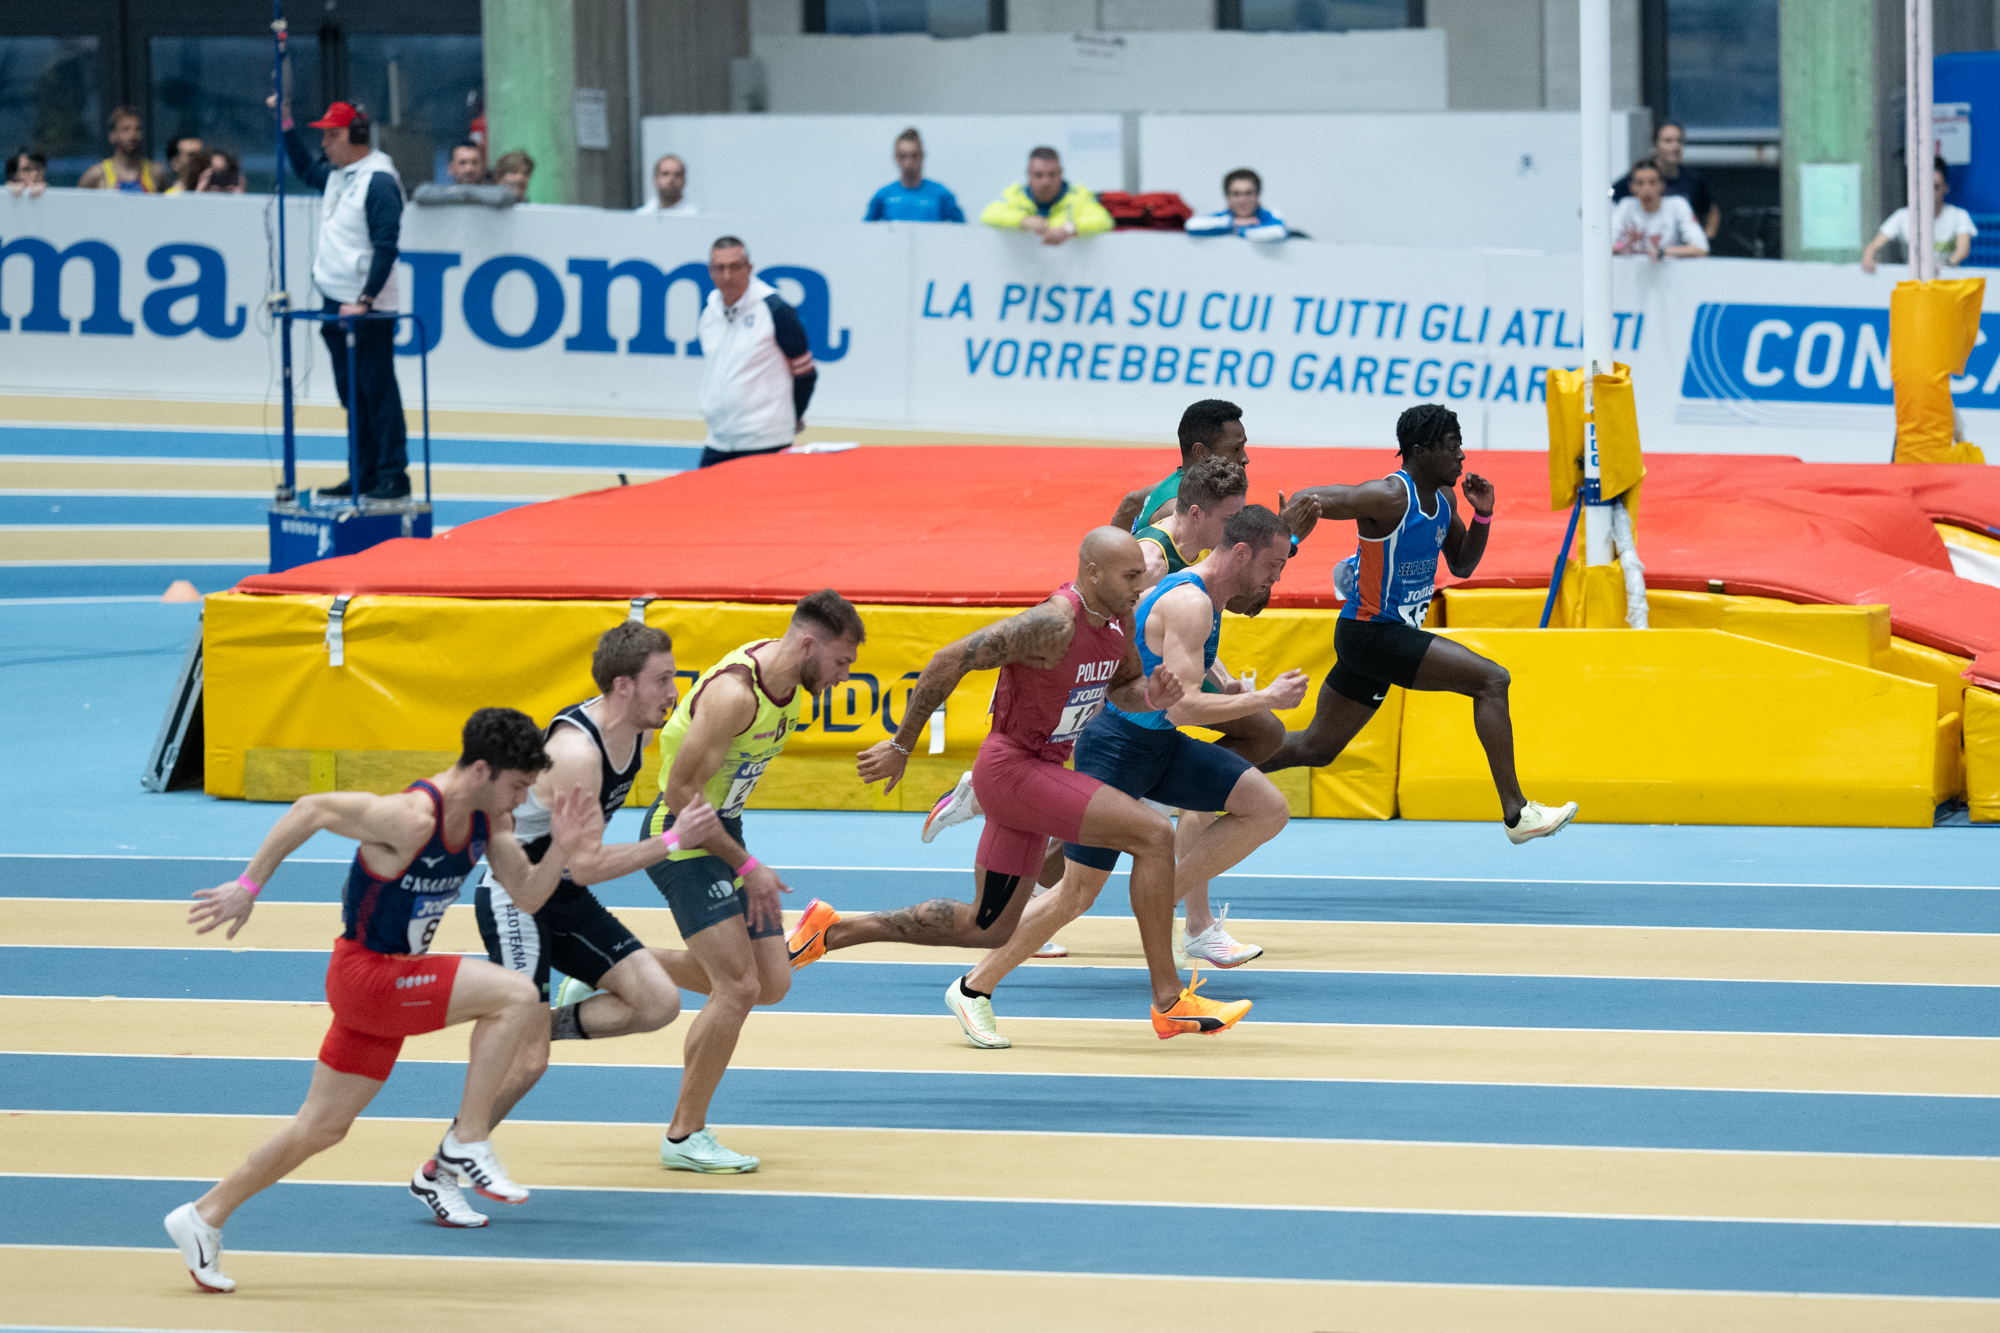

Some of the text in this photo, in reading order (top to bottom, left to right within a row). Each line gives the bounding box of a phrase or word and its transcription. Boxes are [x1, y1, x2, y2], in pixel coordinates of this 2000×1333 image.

[922, 280, 1645, 351] LA PISTA SU CUI TUTTI GLI ATLTI
[965, 338, 1580, 403] VORREBBERO GAREGGIAR
[506, 903, 527, 971] BIOTEKNA
